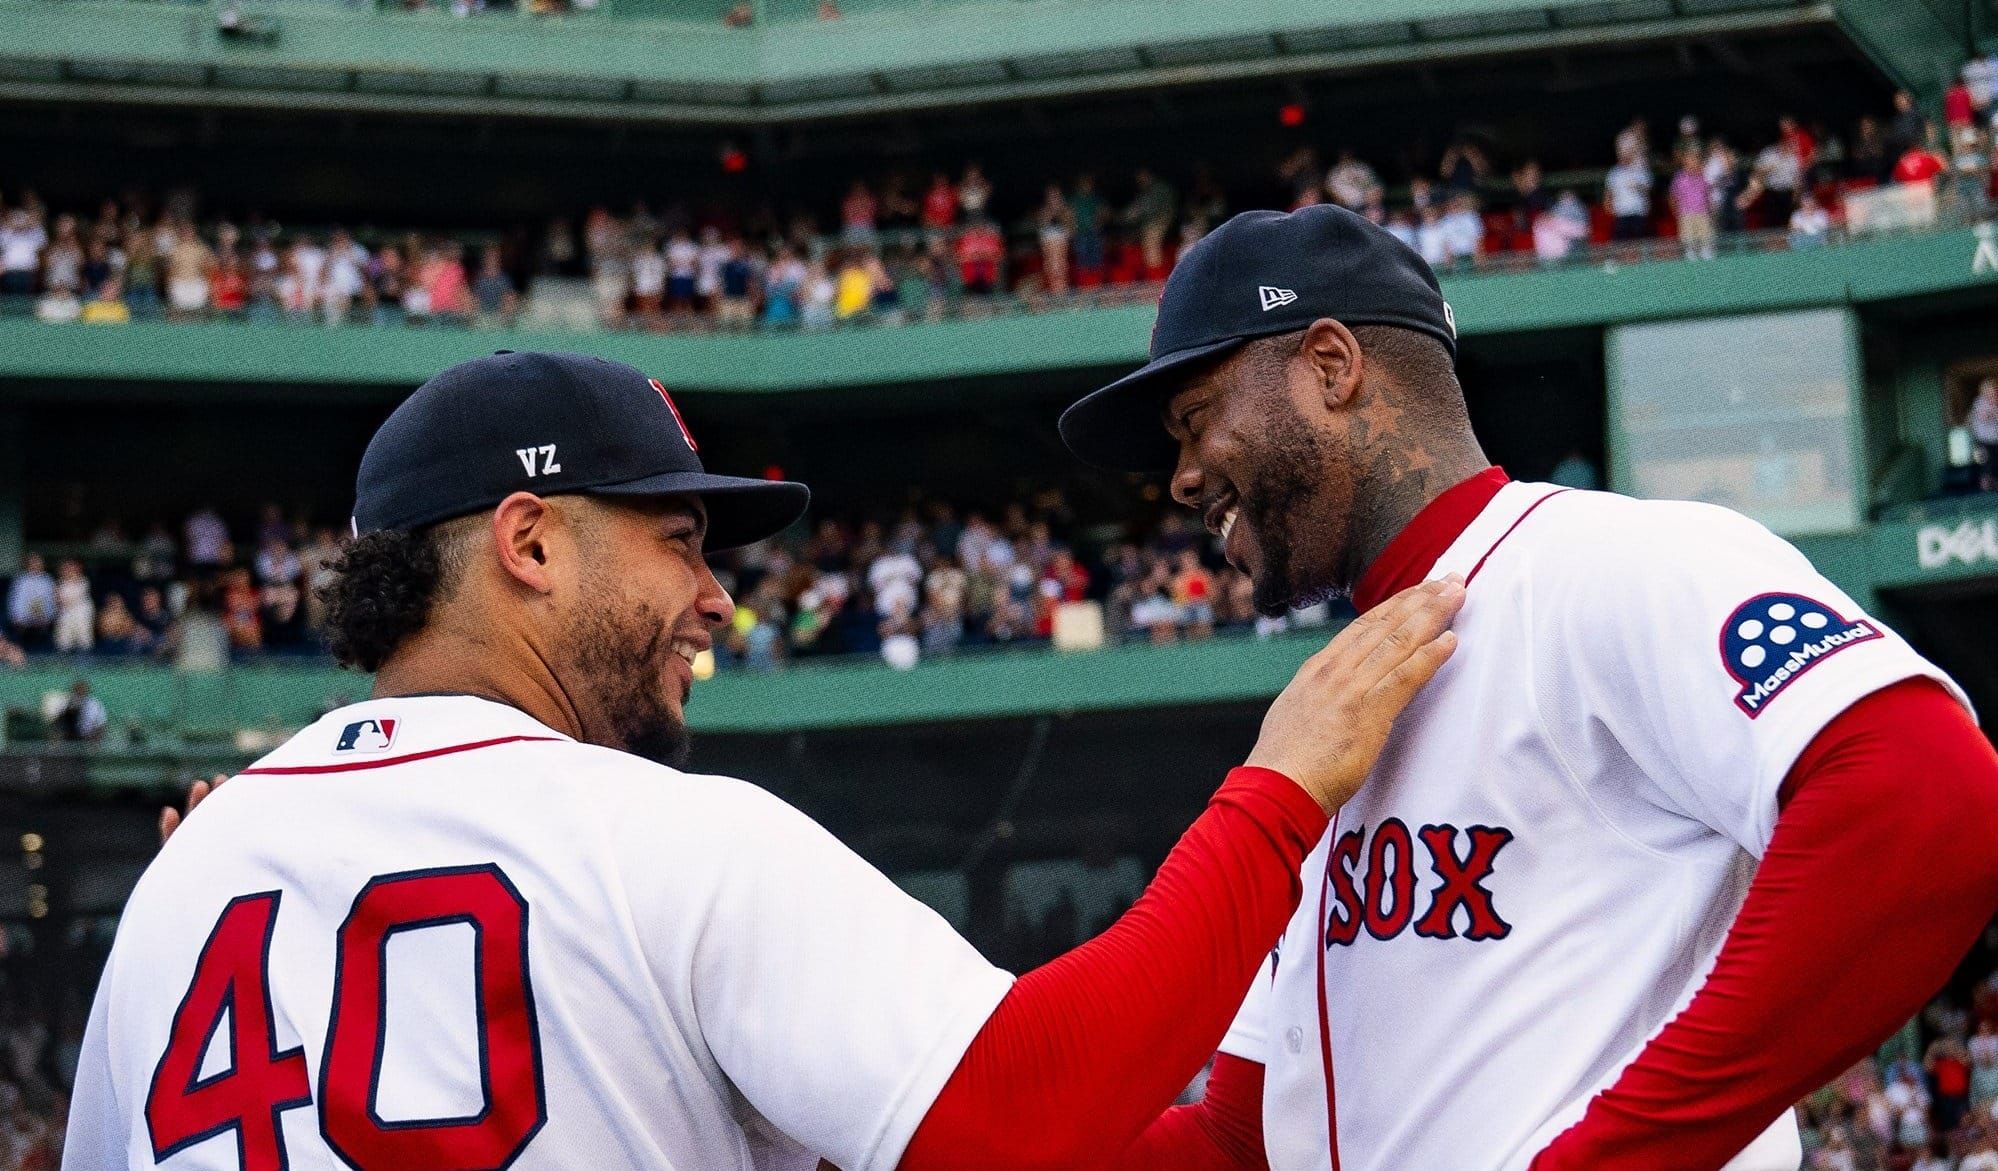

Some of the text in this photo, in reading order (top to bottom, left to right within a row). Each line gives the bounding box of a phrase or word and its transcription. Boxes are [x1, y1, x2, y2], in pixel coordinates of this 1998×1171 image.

[516, 444, 561, 478] VZ
[1742, 622, 1873, 709] MassMutual
[1326, 817, 1514, 950] SOX
[144, 862, 547, 1171] 40
